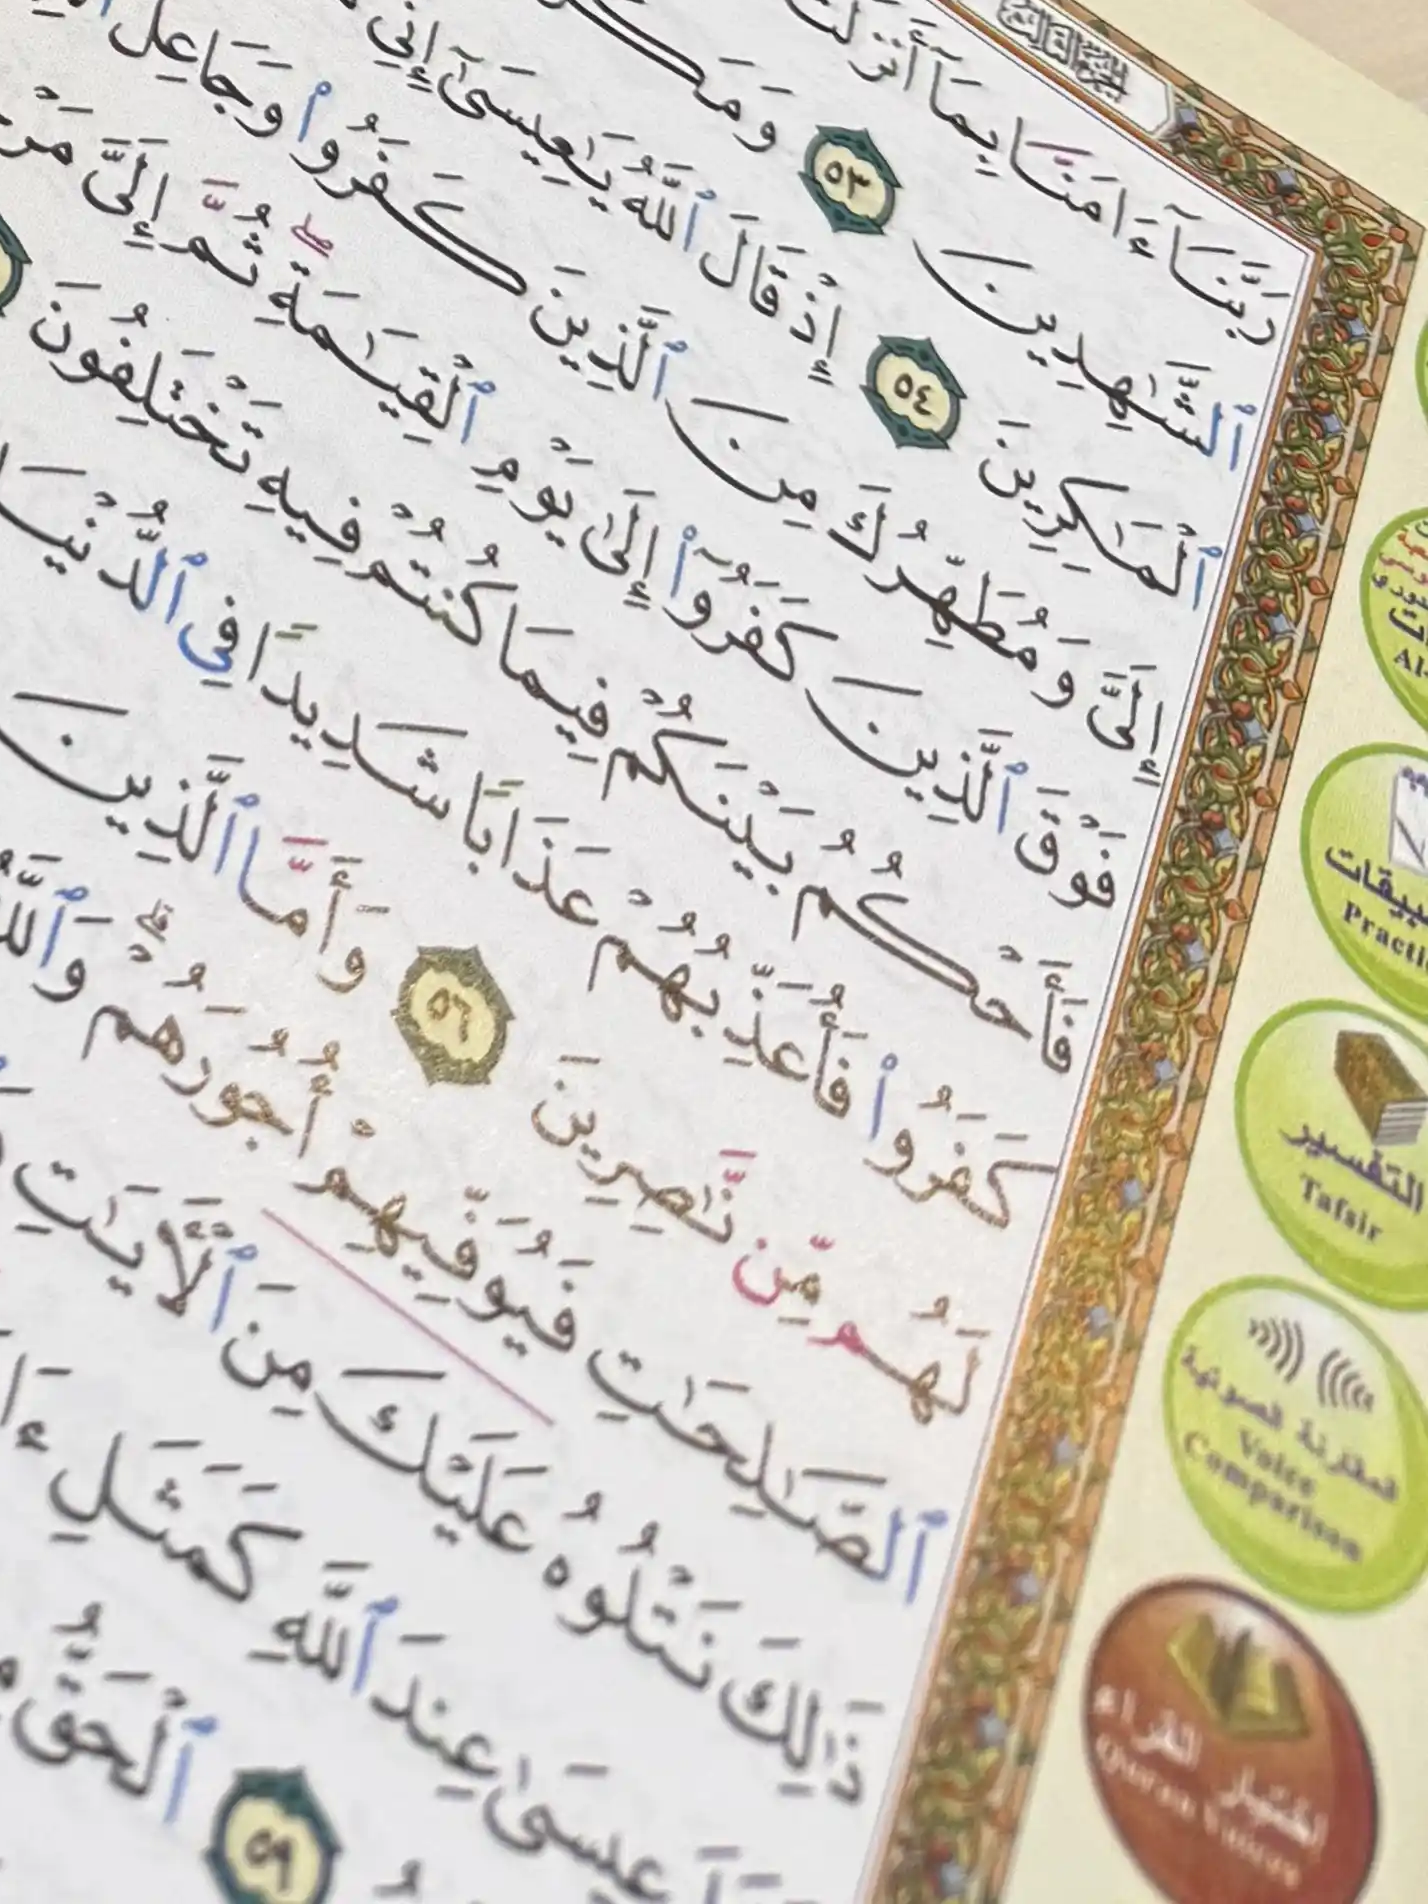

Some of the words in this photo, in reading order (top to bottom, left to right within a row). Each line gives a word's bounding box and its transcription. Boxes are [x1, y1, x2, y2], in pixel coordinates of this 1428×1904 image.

[1343, 899, 1428, 972] Practi
[1299, 1172, 1384, 1245] Tafsir
[1184, 1432, 1364, 1563] Comparison
[1239, 1427, 1316, 1498] Voice
